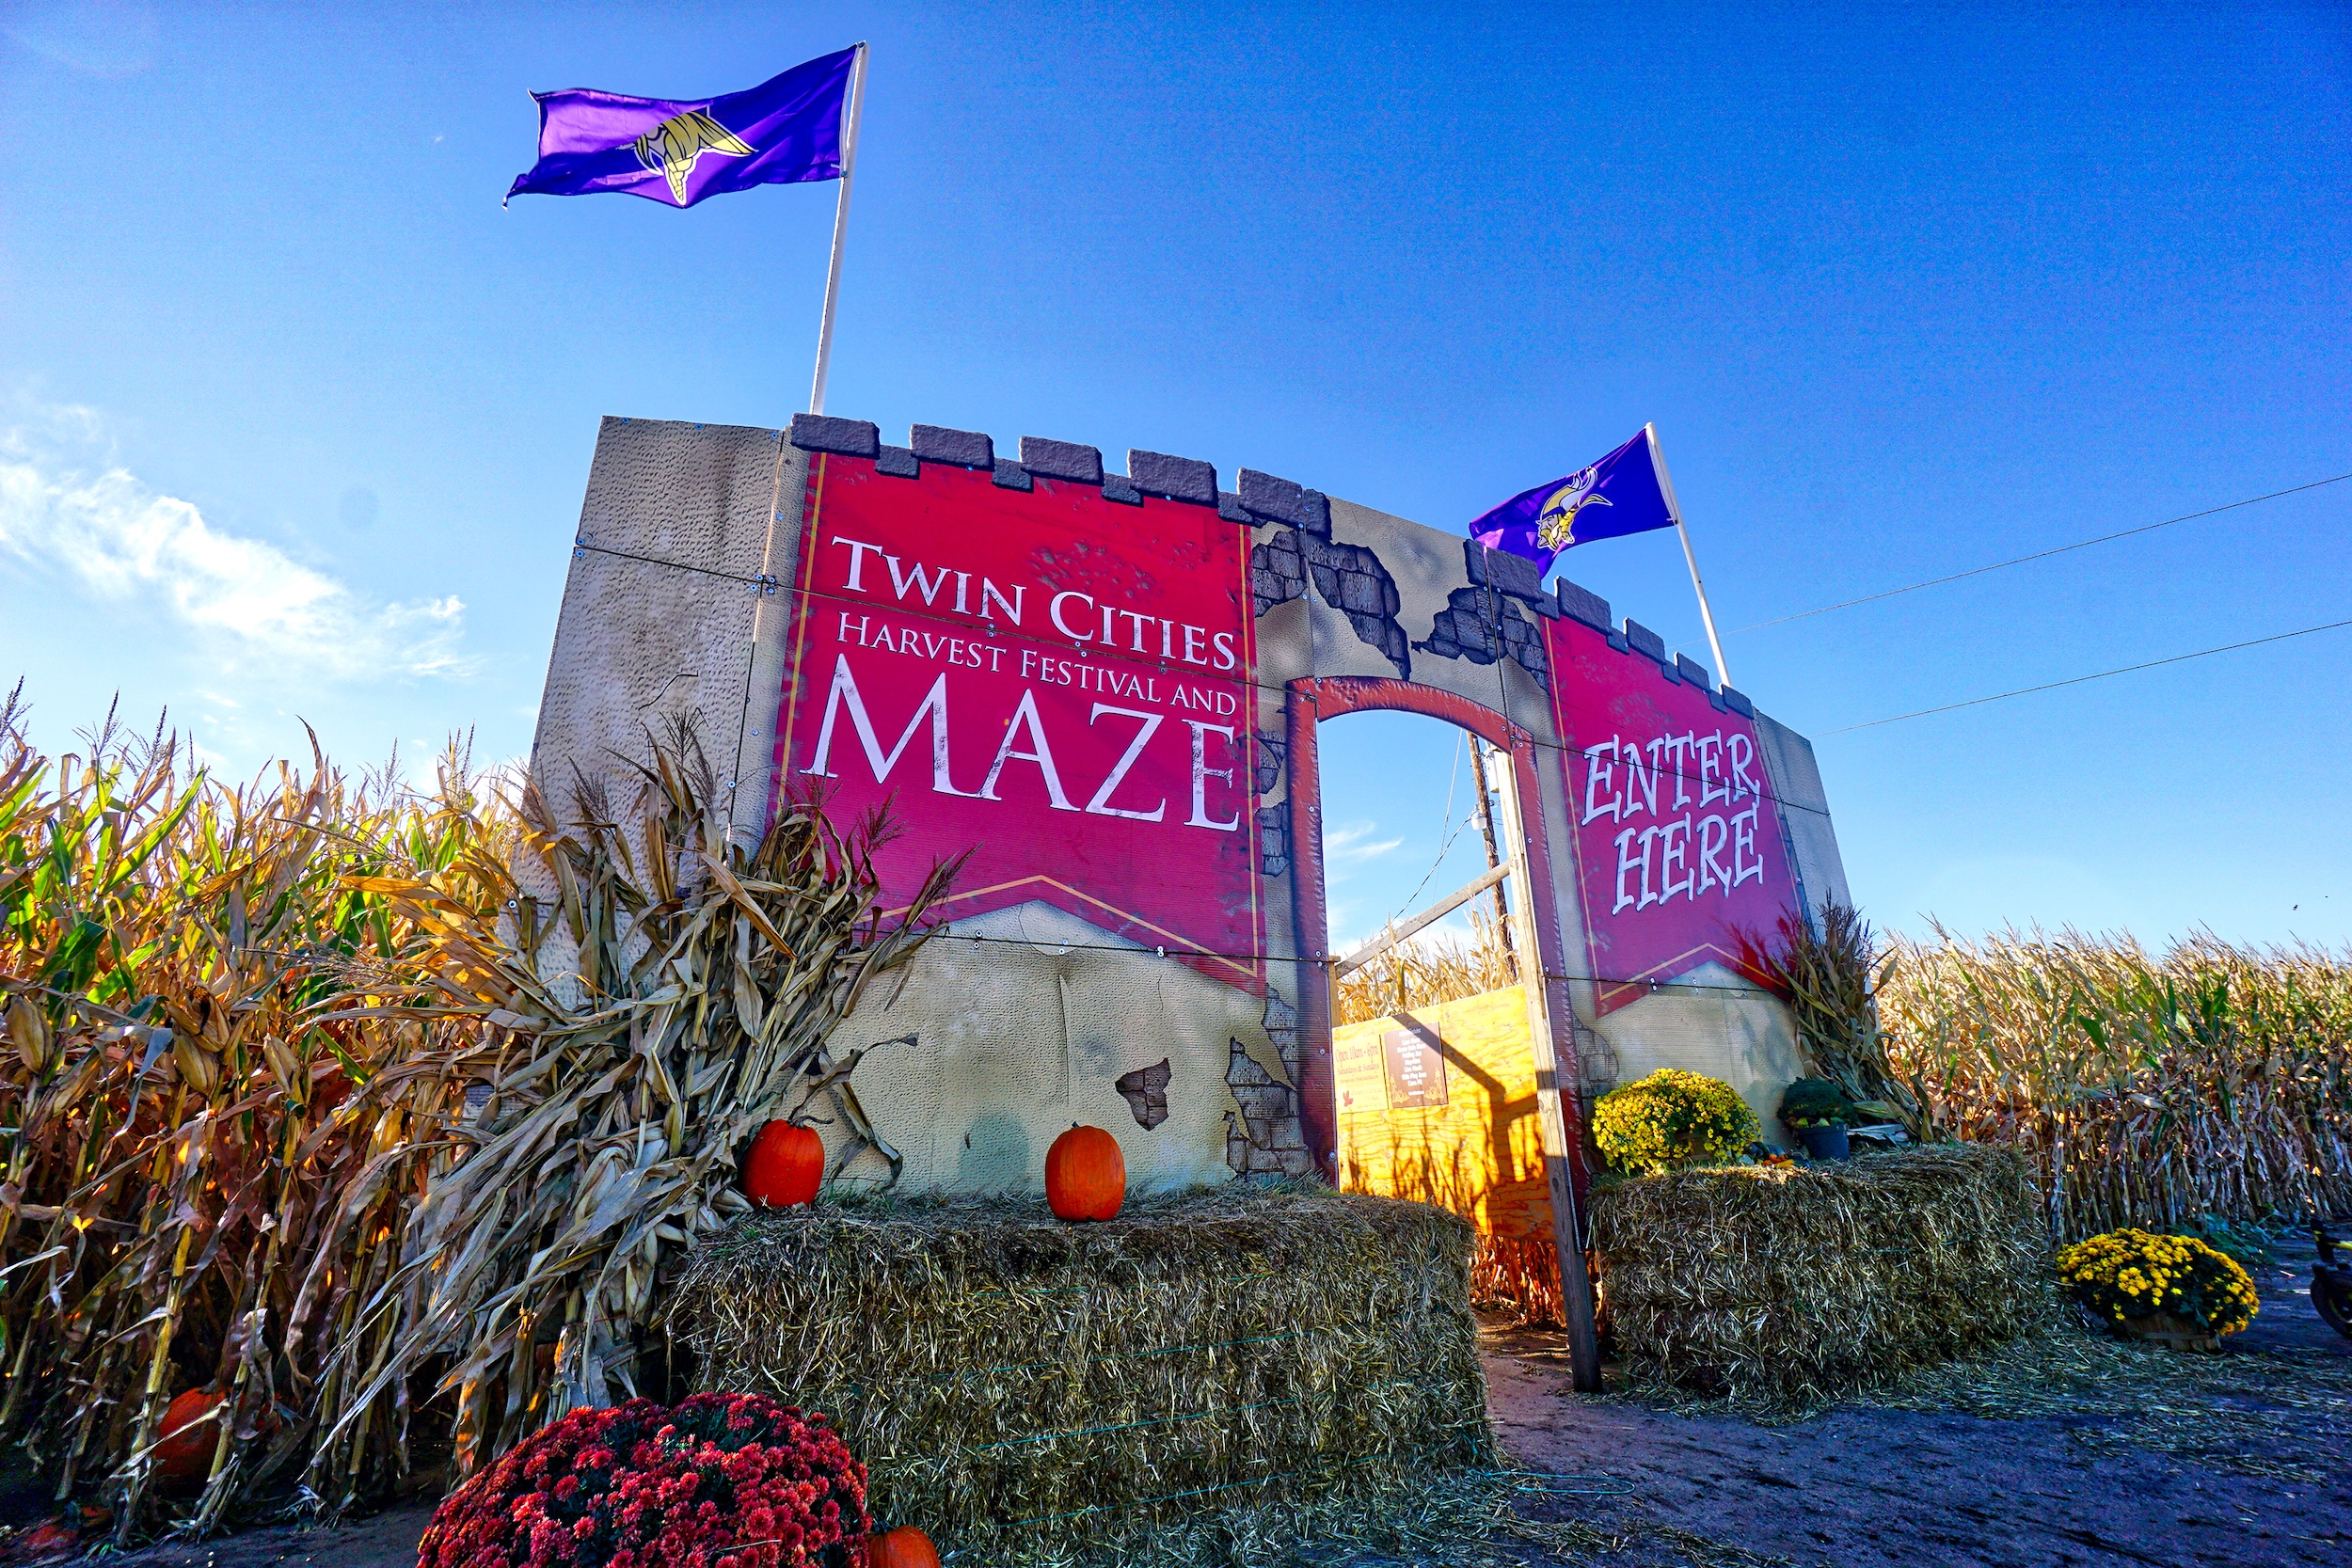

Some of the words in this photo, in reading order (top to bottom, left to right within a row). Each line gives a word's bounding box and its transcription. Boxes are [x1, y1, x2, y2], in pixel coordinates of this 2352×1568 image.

[831, 535, 1026, 626] TWIN
[1049, 590, 1236, 671] CITIES
[836, 611, 1007, 673] HARVEST
[1020, 649, 1162, 704] FESTIVAL
[1169, 683, 1236, 717] AND
[799, 653, 1239, 832] MAZE
[1581, 728, 1760, 827] ENTER
[1611, 801, 1764, 916] HERE
[1336, 1048, 1349, 1068] Open
